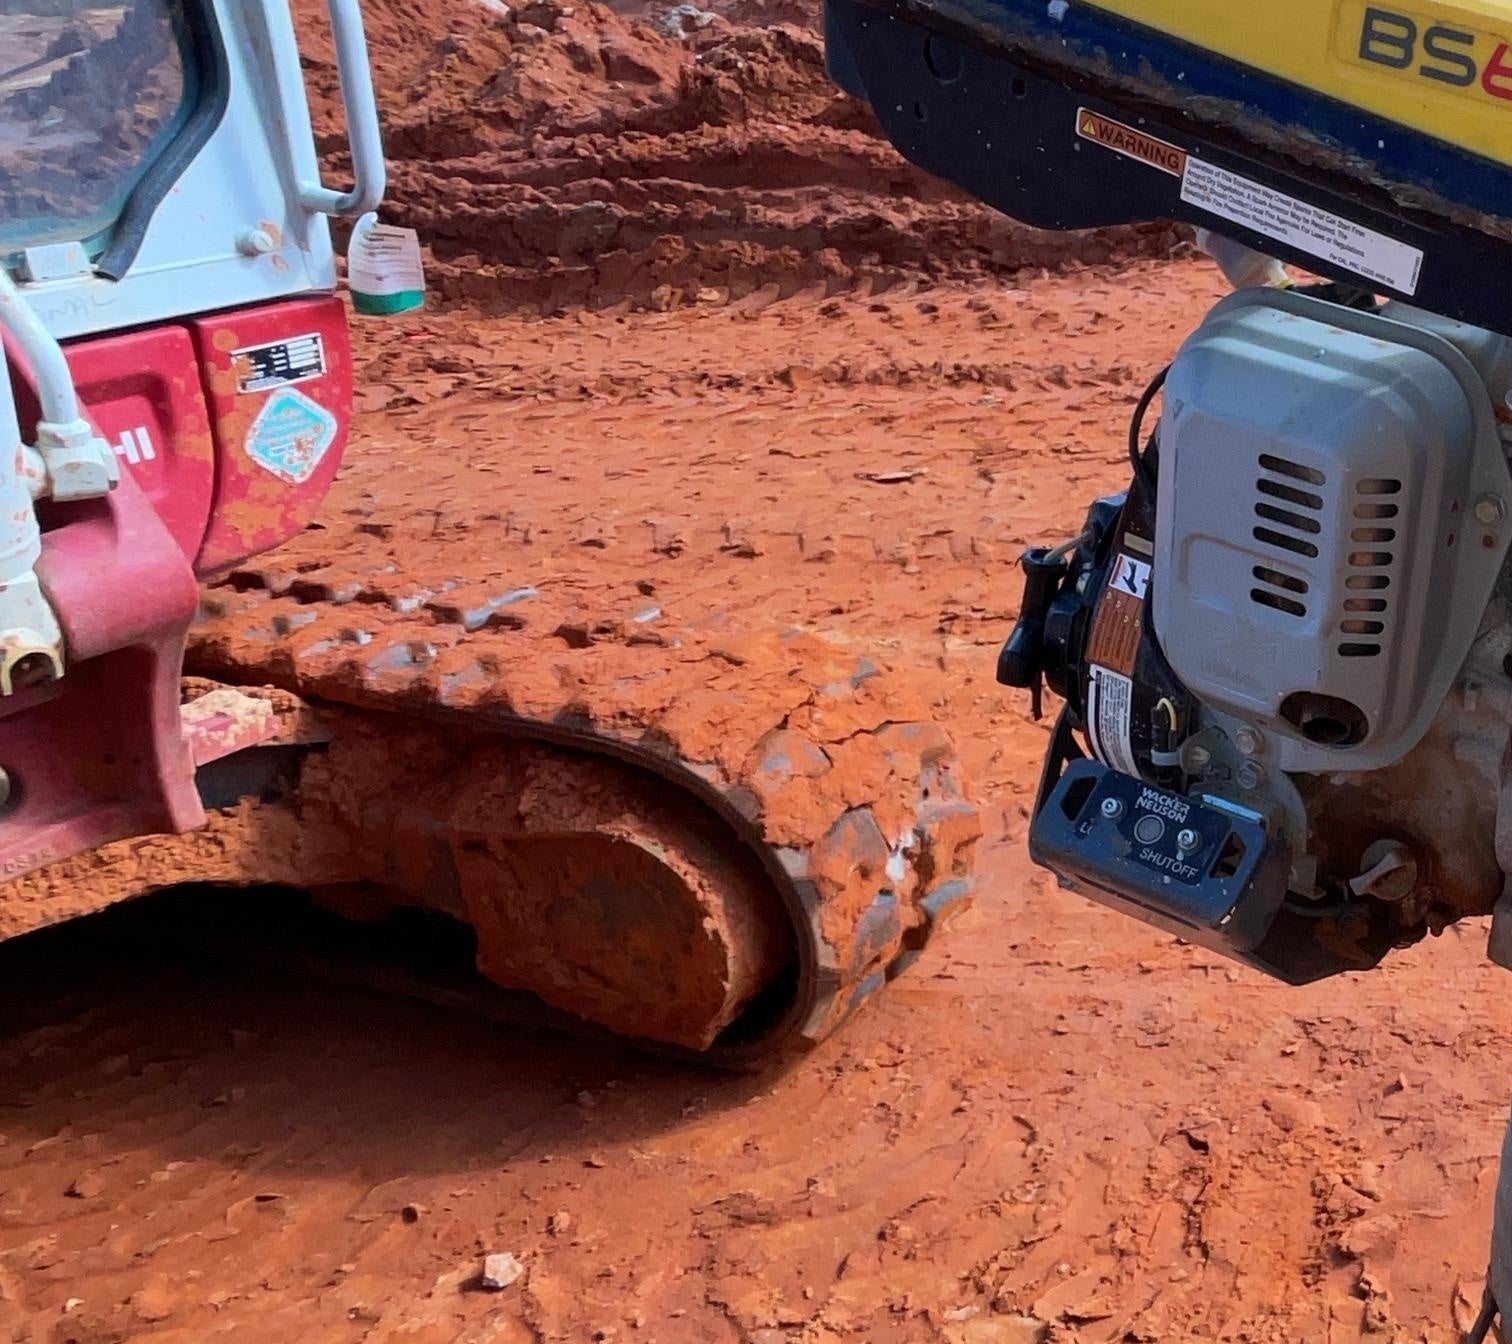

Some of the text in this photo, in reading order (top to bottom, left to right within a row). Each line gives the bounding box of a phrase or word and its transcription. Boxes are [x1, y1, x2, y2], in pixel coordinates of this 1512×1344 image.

[1099, 123, 1180, 169] WARNING
[1135, 796, 1187, 823] NEUSON
[1141, 787, 1190, 814] WACKER
[1139, 847, 1200, 879] SHUTOFF
